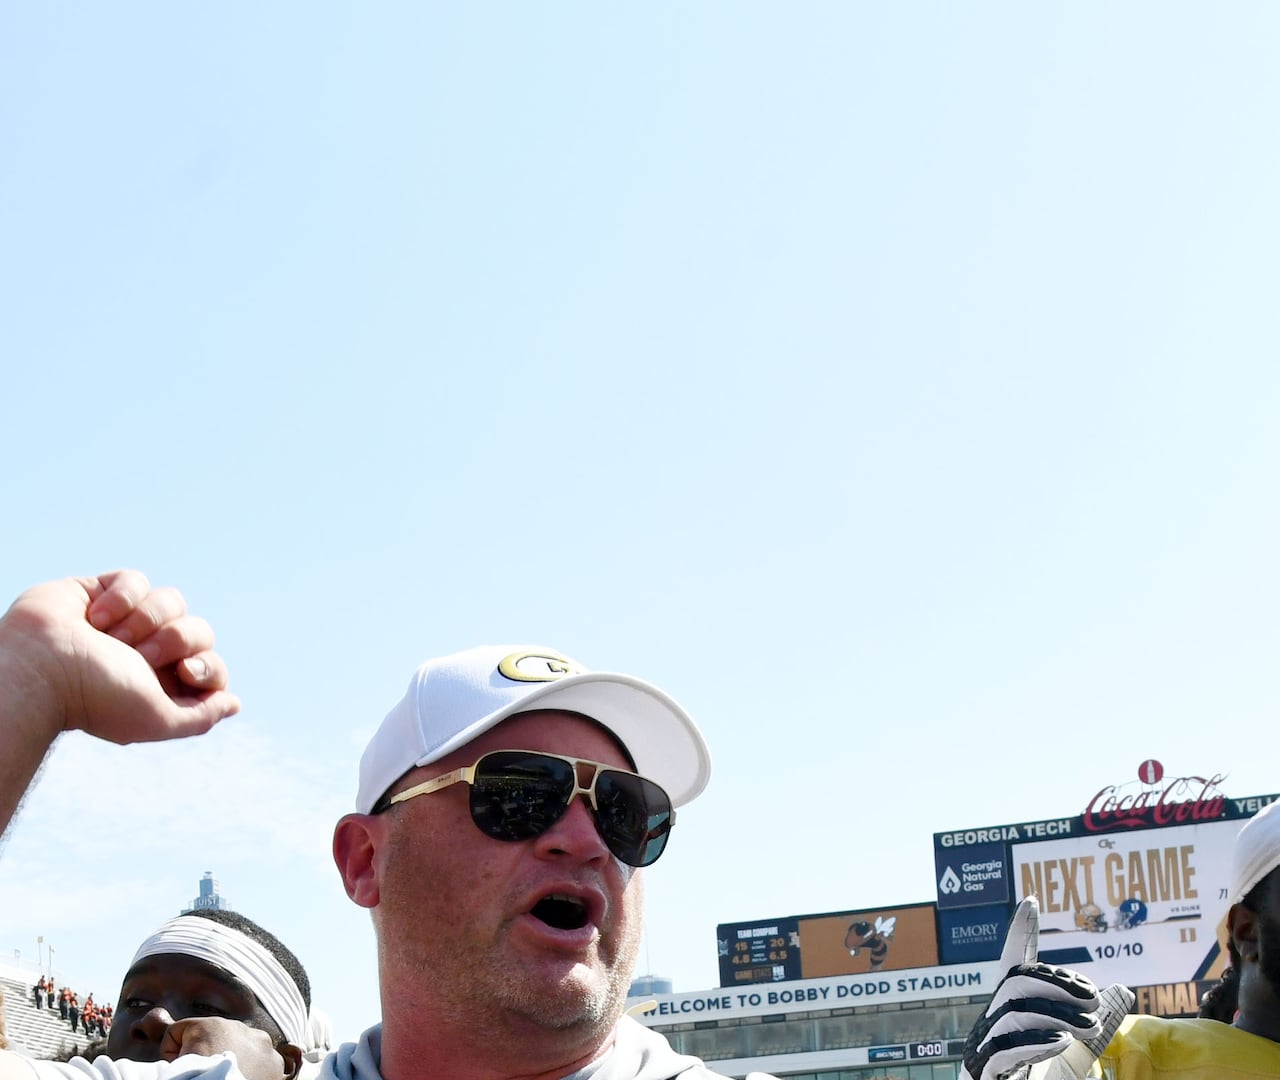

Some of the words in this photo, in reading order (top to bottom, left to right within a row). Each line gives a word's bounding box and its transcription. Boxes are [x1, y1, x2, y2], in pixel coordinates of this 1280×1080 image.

[1083, 773, 1230, 832] Coca-Cola
[941, 827, 1019, 847] GEORGIA
[1024, 820, 1070, 838] TECH
[962, 860, 1002, 873] Georgia
[962, 870, 1002, 882] Natural
[1020, 856, 1095, 915] NEXT
[1105, 845, 1198, 907] GAME
[964, 883, 984, 892] Gas
[952, 923, 998, 939] EMORY
[1095, 942, 1143, 960] 10/10
[642, 995, 731, 1017] WELCOME
[737, 994, 761, 1009] TO
[768, 986, 830, 1005] BOBBY
[837, 980, 891, 998] DODD
[898, 972, 982, 992] STADIUM
[1138, 982, 1199, 1016] FINAL
[917, 1043, 942, 1057] 0:00
